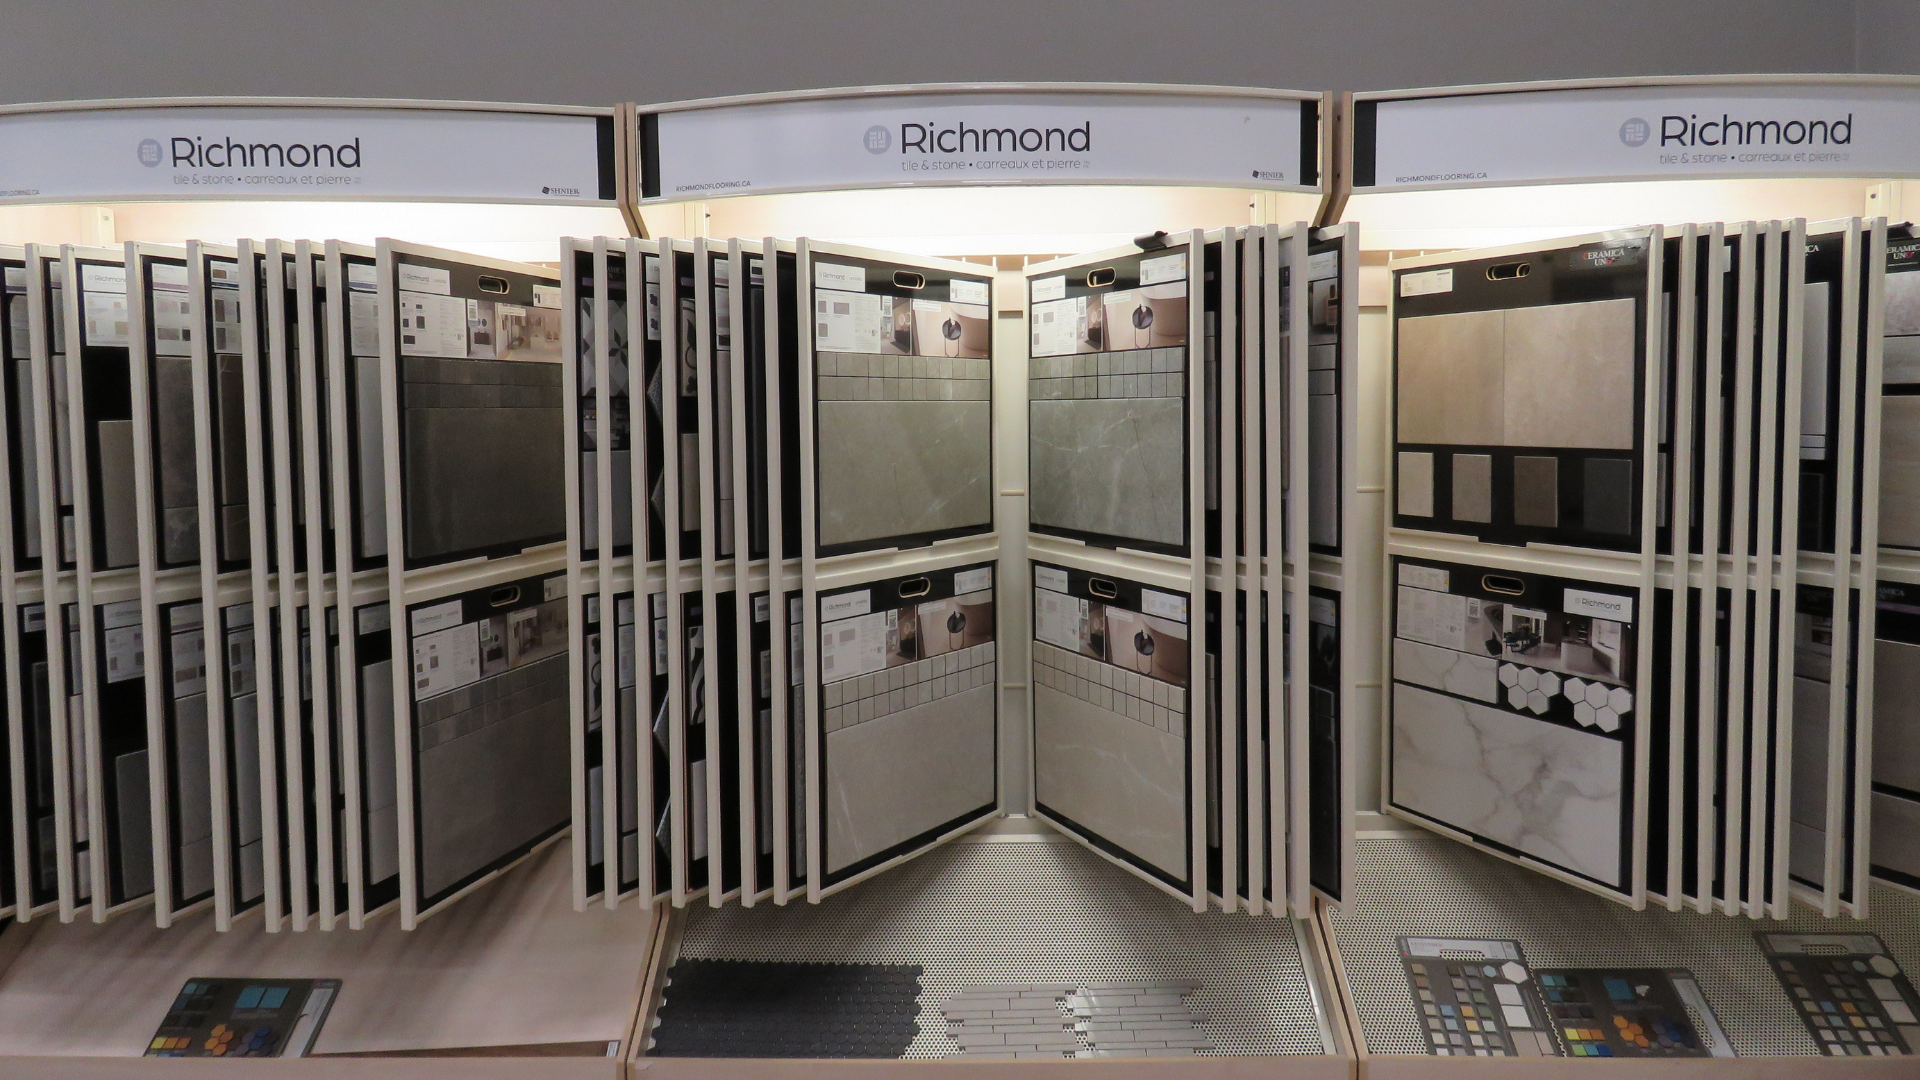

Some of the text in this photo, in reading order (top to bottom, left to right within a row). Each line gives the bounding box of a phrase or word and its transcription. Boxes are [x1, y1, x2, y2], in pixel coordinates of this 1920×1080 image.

[1660, 113, 1852, 147] Richmond
[901, 121, 1090, 154] Richmond
[171, 136, 361, 168] Richmond
[1659, 153, 1677, 164] tile
[1680, 153, 1689, 164] &
[1692, 152, 1728, 163] stone
[1738, 152, 1791, 163] carreaux
[1793, 151, 1806, 162] et
[1808, 151, 1841, 163] pierre
[901, 160, 919, 171] tile
[921, 160, 930, 171] &
[932, 159, 966, 171] stone
[976, 159, 1029, 170] carreaux
[1031, 159, 1044, 170] et
[1046, 158, 1081, 171] pierre
[173, 174, 189, 185] tile
[191, 174, 200, 185] &
[202, 174, 234, 185] stone
[244, 174, 298, 185] carreaux
[300, 174, 313, 185] et
[316, 174, 351, 186] pierre
[1259, 171, 1284, 179] SHNIER
[1395, 172, 1488, 183] RICHMONDFLOORING.CA
[551, 187, 580, 195] SHNIER
[675, 180, 751, 192] RICHMONDFLOORING.CA
[1582, 248, 1625, 260] CERAMICA
[95, 274, 126, 283] Richmon
[1581, 597, 1621, 611] Richmond
